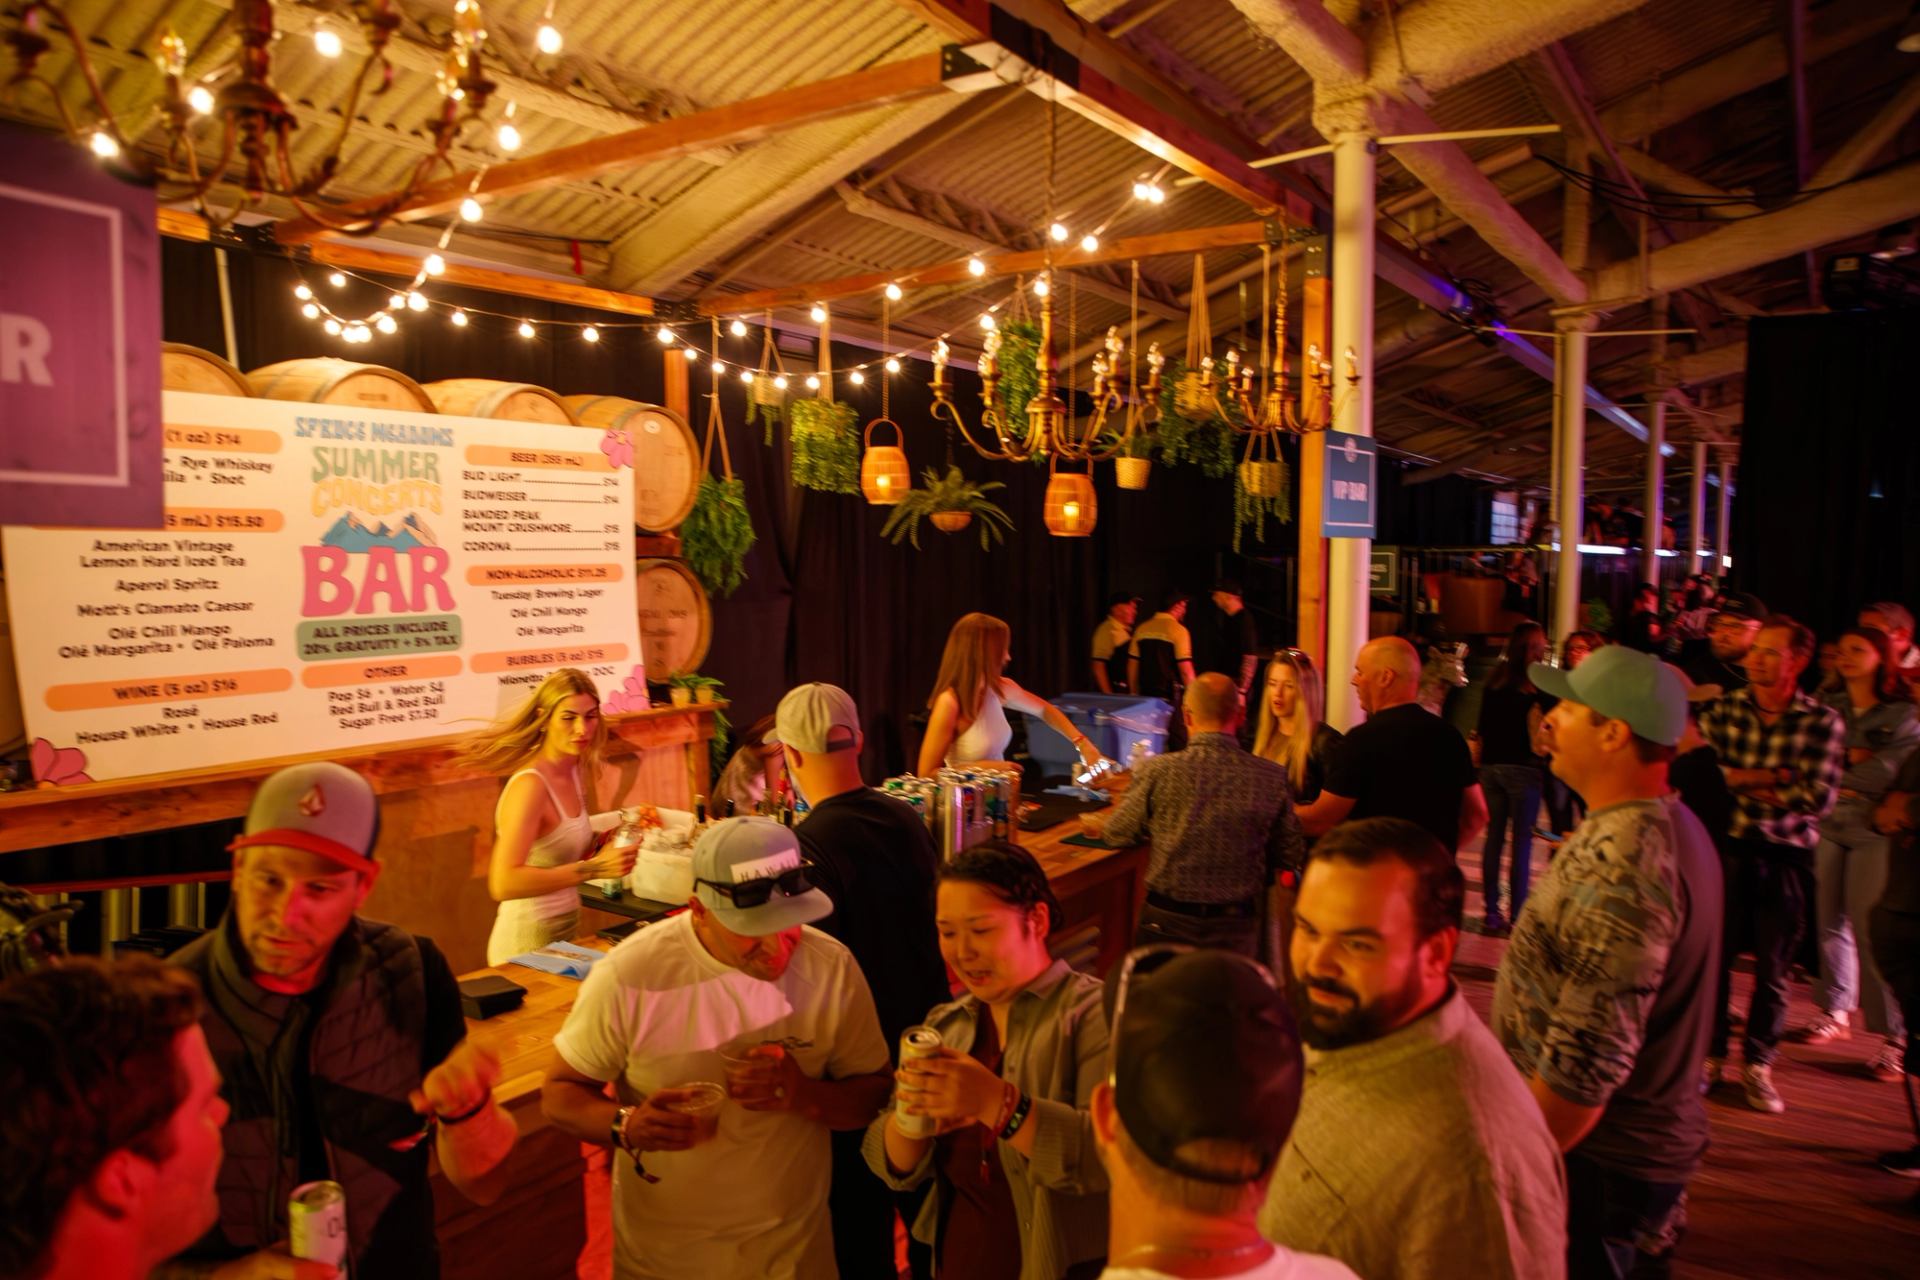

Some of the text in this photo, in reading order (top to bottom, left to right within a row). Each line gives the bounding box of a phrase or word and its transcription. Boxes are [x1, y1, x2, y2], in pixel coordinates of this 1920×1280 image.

[180, 455, 273, 473] Rye Whiskey
[311, 446, 441, 484] SUMMER
[511, 452, 537, 463] BEER
[210, 472, 246, 485] Shot
[463, 470, 486, 481] BUD
[489, 472, 521, 483] LIGHT
[311, 478, 443, 518] CONCERTS
[463, 489, 527, 501] BUDWEISER
[463, 509, 542, 520] BANDED PEAK
[463, 522, 504, 533] MOUNT
[507, 522, 573, 534] CRUSHMORE
[93, 539, 234, 554] American Vintage
[463, 541, 512, 552] CORONA
[79, 554, 247, 568] Lemon Hard Iced Tea
[300, 545, 456, 617] BAR
[487, 568, 575, 580] NON-ALCOHOLIC
[115, 577, 220, 593] Aperol Spritz
[491, 587, 604, 601] Tuesday Brewing Lager
[77, 600, 256, 617] Mott's Clamato Caesar
[556, 606, 588, 617] Mango
[108, 624, 231, 640] Olé Chili Mango
[312, 620, 449, 639] ALL PRICES INCLUDE
[537, 622, 585, 636] Margarita
[59, 636, 276, 659] Olé Margarita Olé Paloma
[334, 638, 399, 653] GRATUITY
[434, 634, 458, 646] TAX
[505, 653, 555, 667] BUBBLES
[364, 665, 408, 679] OTHER
[112, 685, 161, 700] WINE
[328, 690, 354, 703] Pop
[390, 685, 426, 696] Water
[161, 704, 198, 719] Rosé
[329, 694, 445, 716] Red Bull & Red Bull
[75, 712, 279, 744] House White House Red
[339, 717, 374, 730] Sugar
[378, 712, 405, 724] Free
